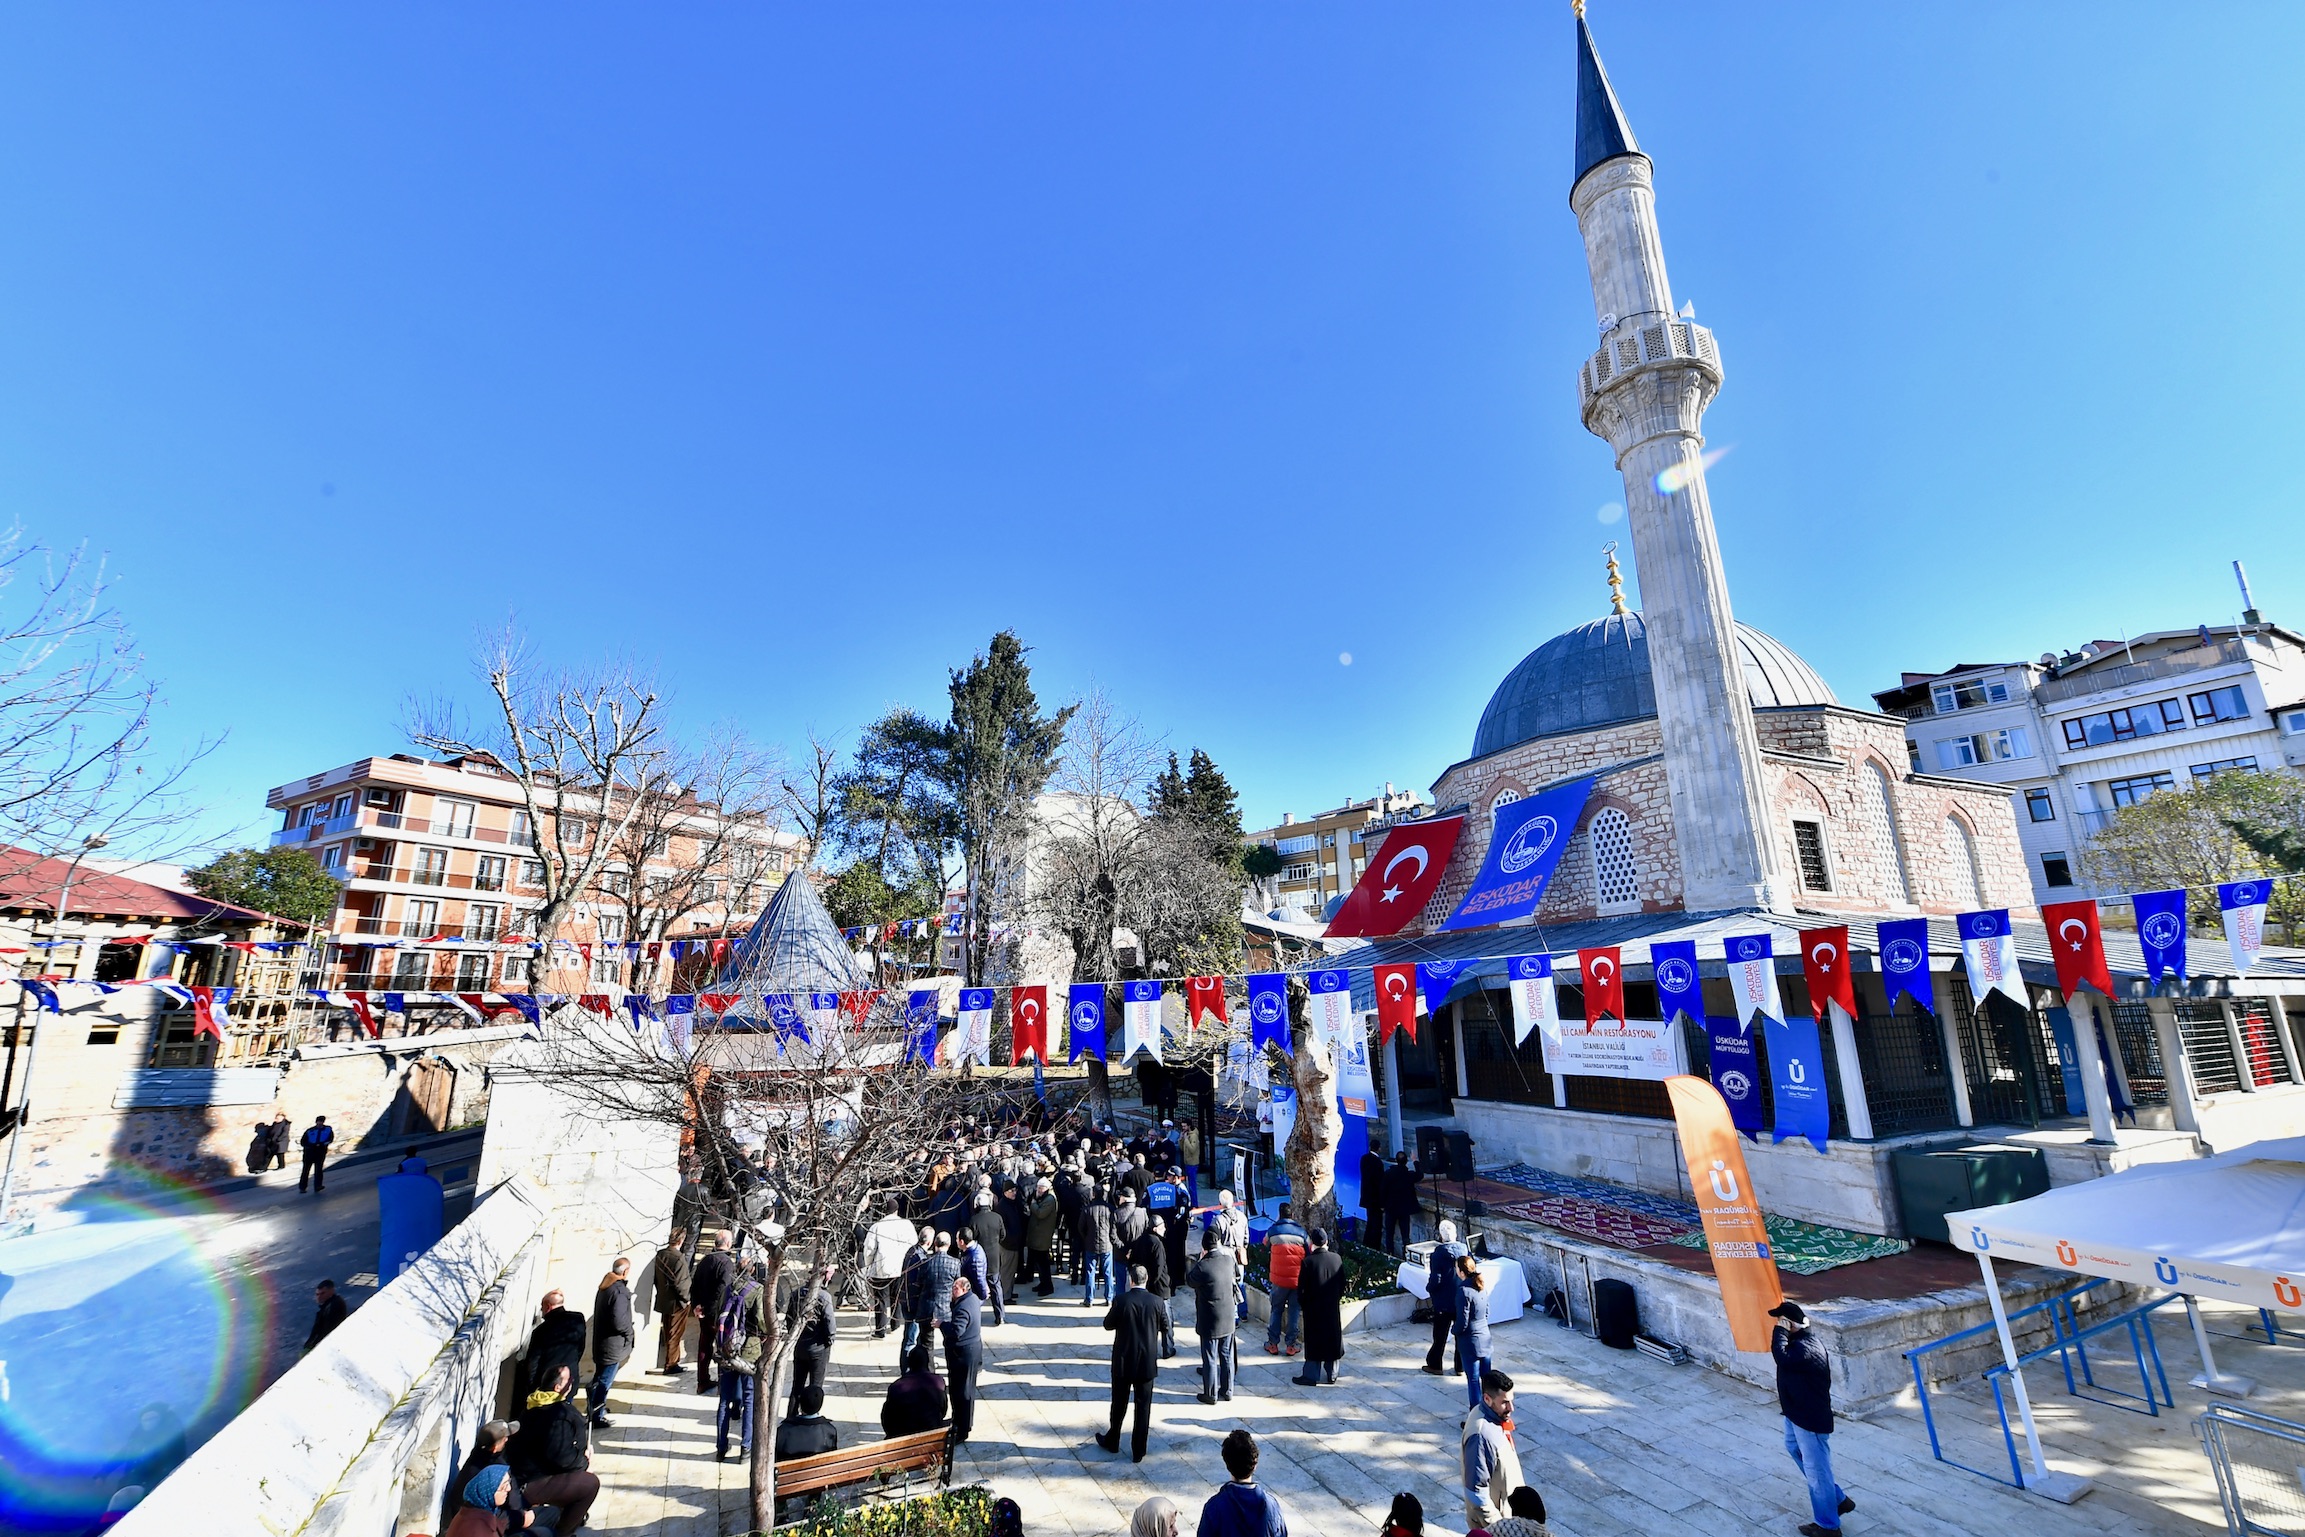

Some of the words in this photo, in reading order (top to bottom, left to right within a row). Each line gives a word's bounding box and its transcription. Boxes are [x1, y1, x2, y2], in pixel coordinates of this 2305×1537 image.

[1470, 875, 1543, 905] ÜSKÜDAR
[1460, 889, 1537, 916] BELEDİYESİ
[1604, 1028, 1657, 1039] RESTORASYONU
[1582, 1041, 1606, 1051] İSTANBUL
[1715, 1035, 1749, 1047] ÜSKÜDAR
[1715, 1045, 1750, 1055] MÜFTÜLÜĞÜ
[2089, 1254, 2120, 1267] ÜSKÜDAR
[2192, 1272, 2228, 1286] ÜSKÜDAR
